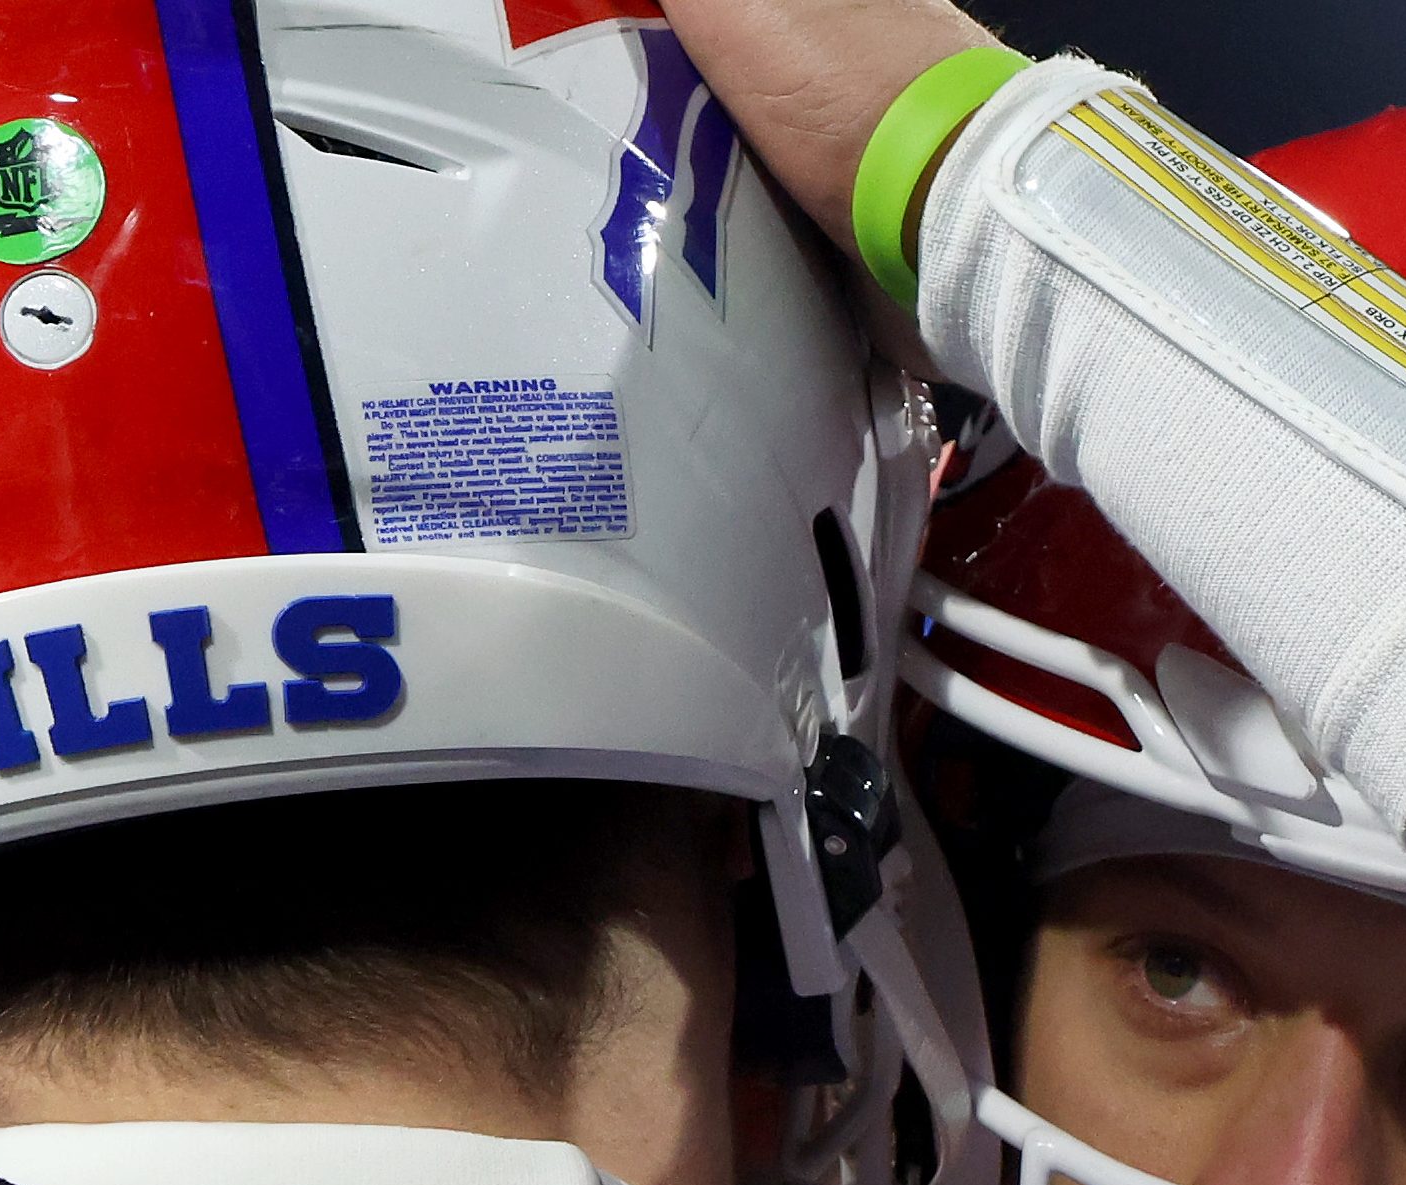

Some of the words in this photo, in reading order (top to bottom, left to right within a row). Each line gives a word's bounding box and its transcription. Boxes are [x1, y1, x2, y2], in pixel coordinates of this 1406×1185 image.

[1167, 156, 1188, 171] SH
[1177, 148, 1223, 183] SHOOT
[1202, 185, 1233, 207] CRS
[1240, 199, 1260, 212] RT
[1258, 212, 1319, 256] SAMURAI
[1364, 306, 1396, 328] ORB
[429, 379, 556, 394] WARNING
[362, 401, 375, 409] NO
[378, 399, 414, 408] HELMET
